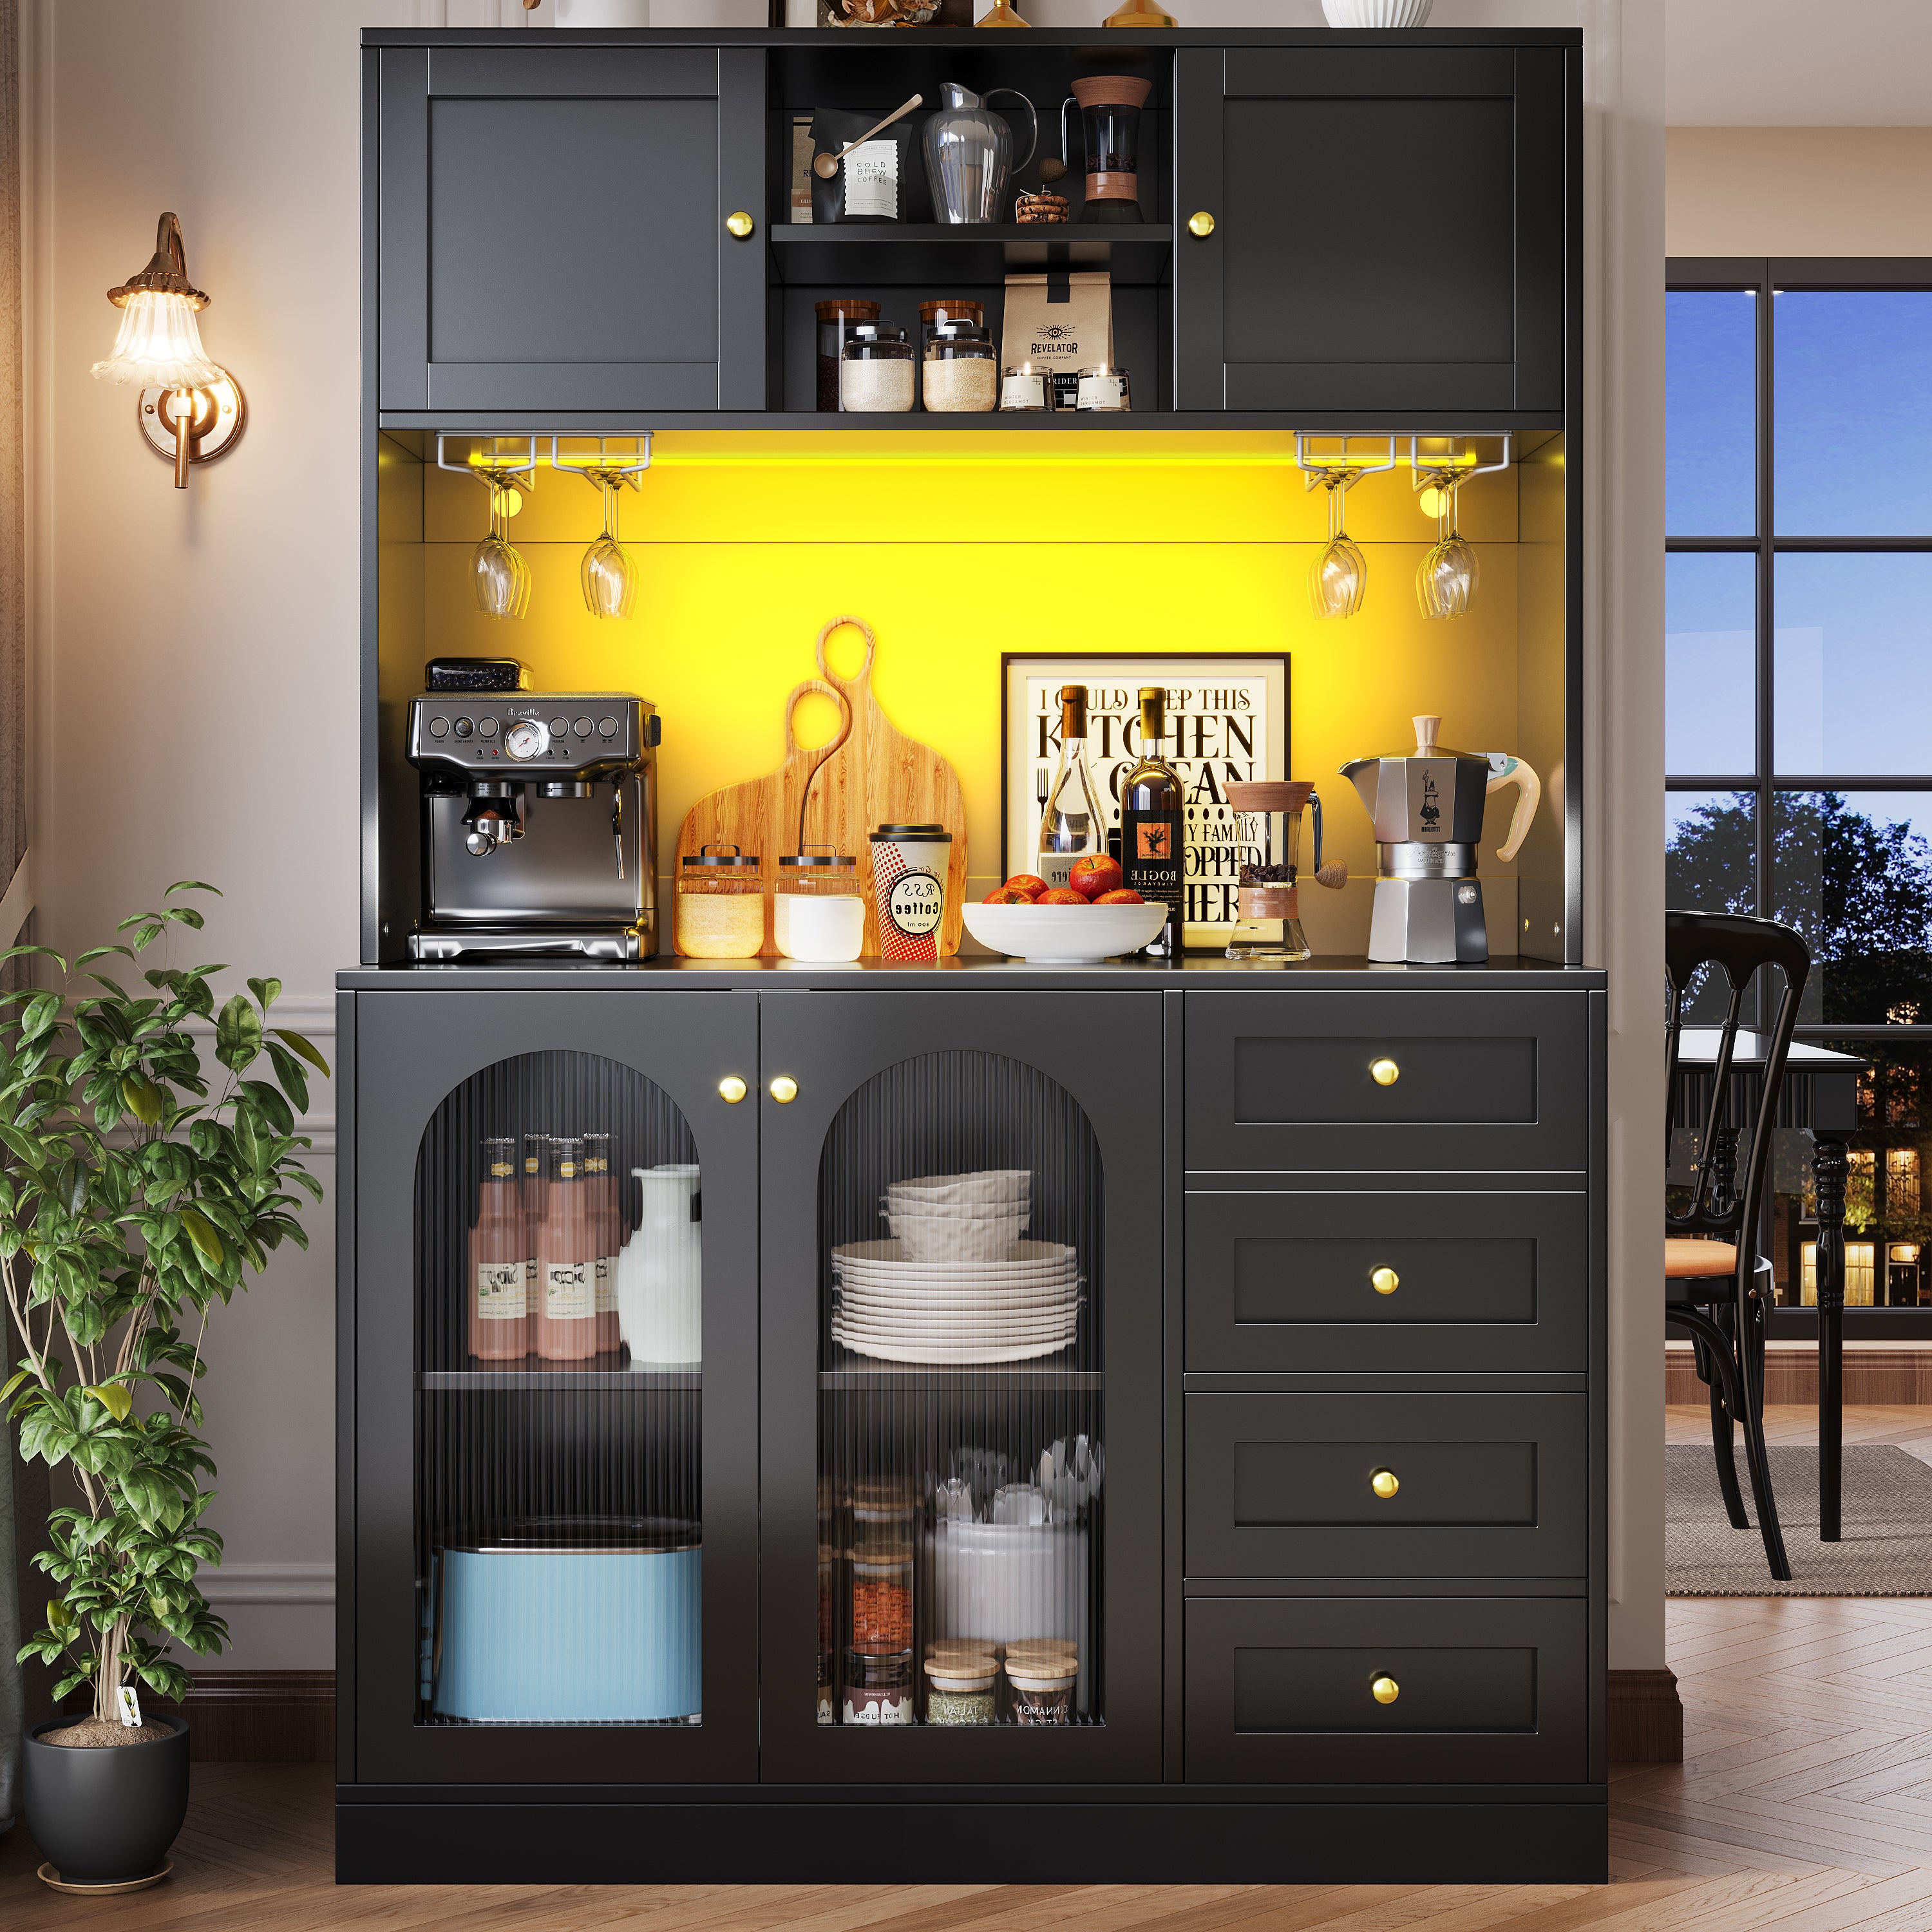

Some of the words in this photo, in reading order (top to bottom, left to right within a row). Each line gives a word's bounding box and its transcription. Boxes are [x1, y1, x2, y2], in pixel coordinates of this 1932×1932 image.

[857, 176, 887, 185] COFFEE
[1031, 343, 1078, 355] REVELATOR
[1040, 689, 1047, 710] I
[1198, 688, 1251, 710] THIS
[1036, 715, 1257, 759] KTCHEN
[1109, 761, 1257, 805] CEAN
